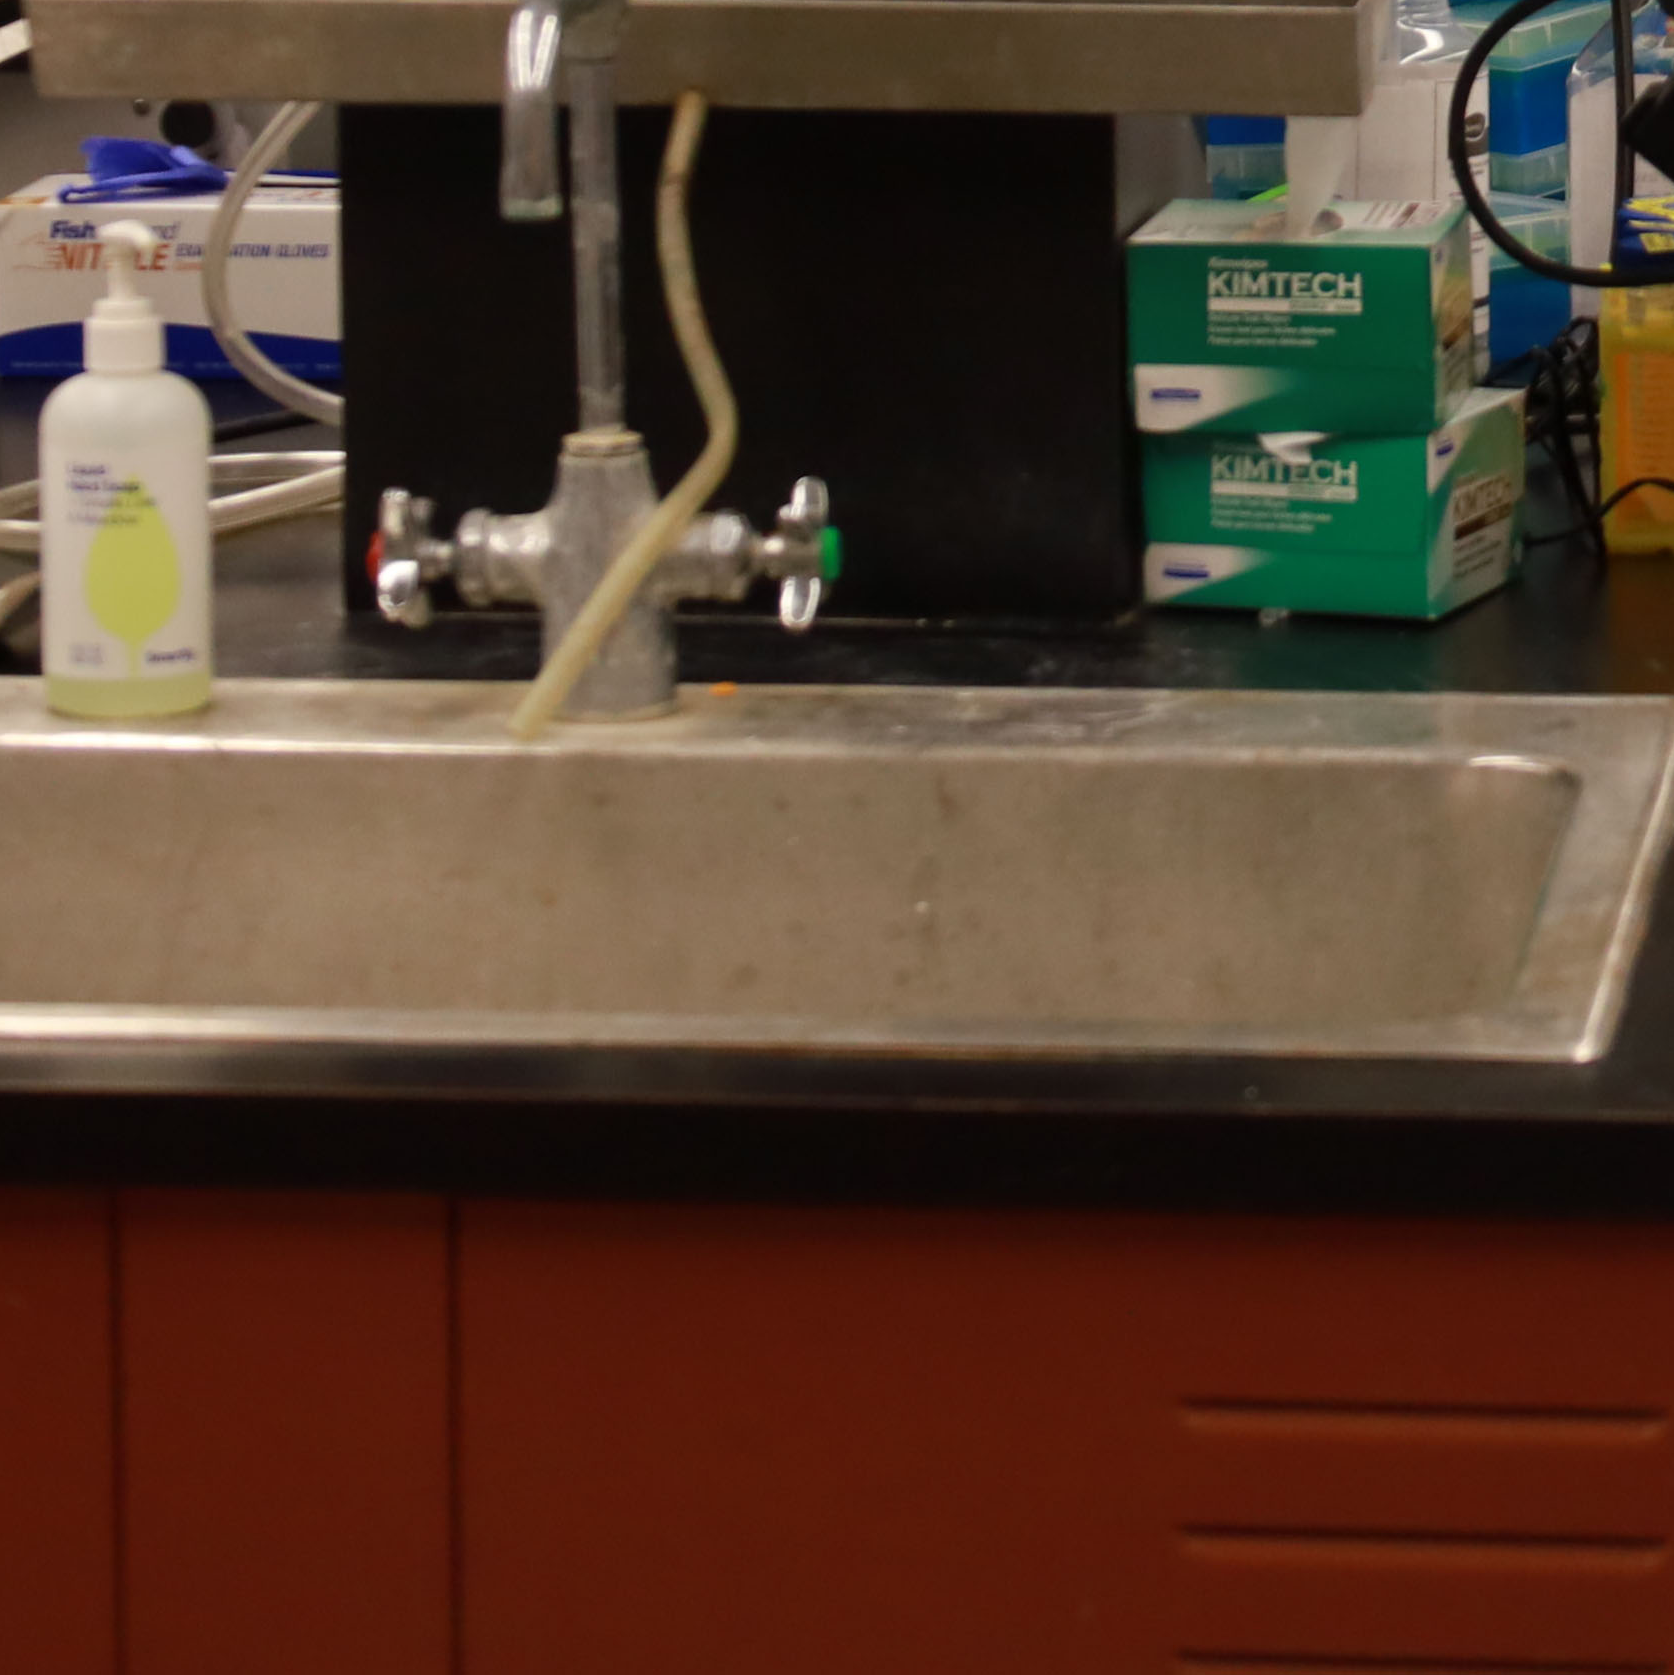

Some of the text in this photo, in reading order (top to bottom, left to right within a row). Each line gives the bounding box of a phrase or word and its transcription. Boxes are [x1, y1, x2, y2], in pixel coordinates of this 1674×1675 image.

[57, 243, 171, 271] NITLE
[1207, 271, 1362, 298] KIMTECH
[1211, 454, 1358, 486] KIMTECH
